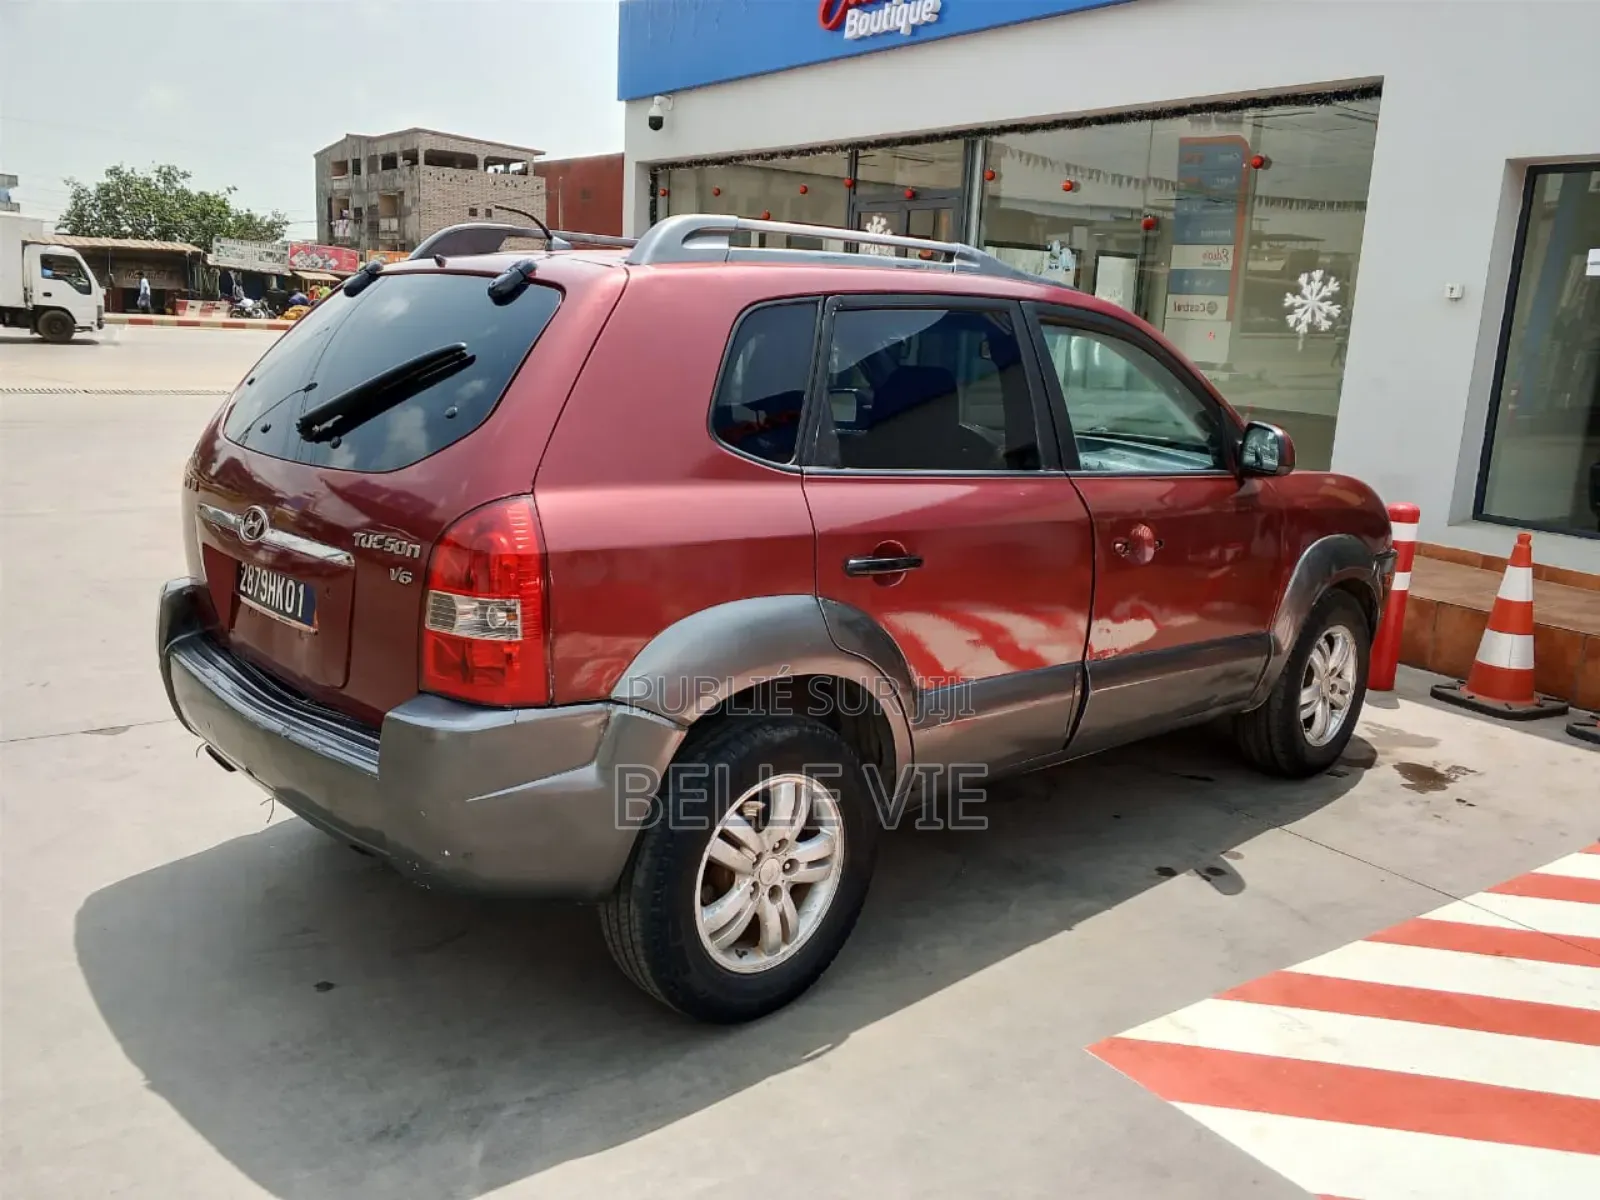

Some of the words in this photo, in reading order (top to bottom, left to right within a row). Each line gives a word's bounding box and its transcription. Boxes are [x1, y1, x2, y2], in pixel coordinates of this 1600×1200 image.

[844, 0, 941, 39] Boutique
[352, 532, 421, 559] TUCSON
[239, 563, 305, 618] 2879HK01
[389, 566, 413, 585] V6
